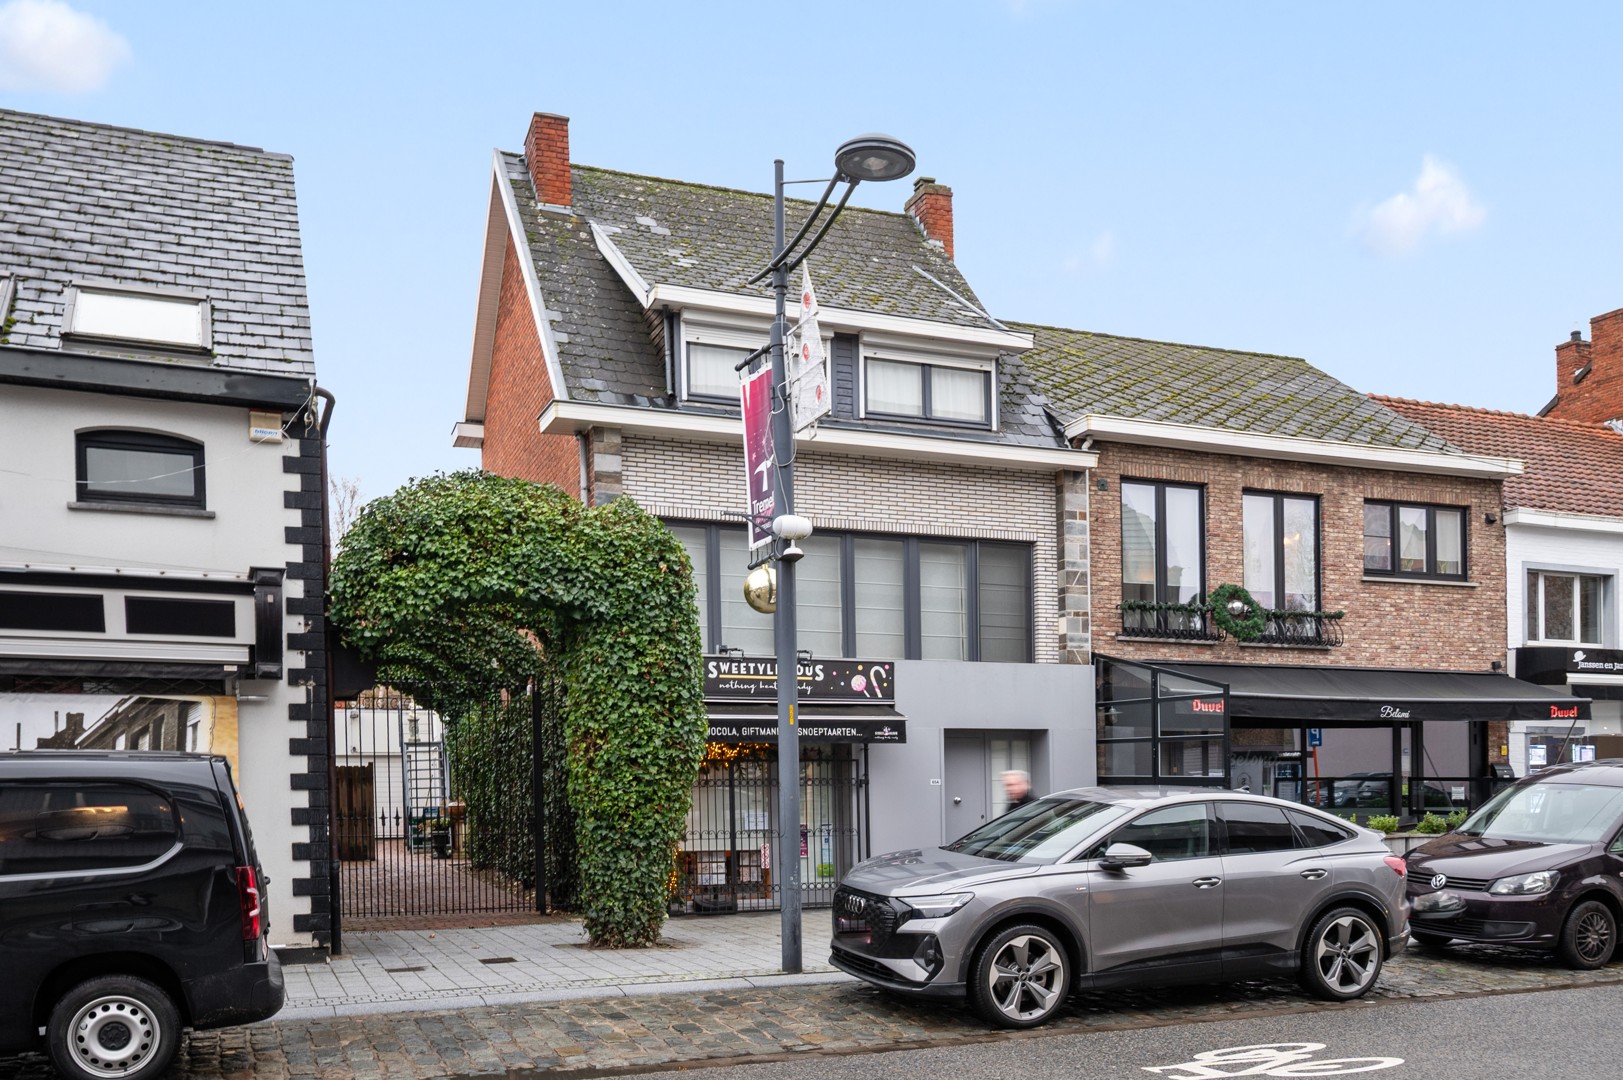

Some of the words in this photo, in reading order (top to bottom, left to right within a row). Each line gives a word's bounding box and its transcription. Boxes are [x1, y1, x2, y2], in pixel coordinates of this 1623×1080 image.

[752, 491, 775, 515] Tremel
[707, 661, 824, 682] SWEETYLIOUS
[719, 680, 757, 694] nothing
[759, 681, 778, 689] beat
[1192, 698, 1225, 713] Duvel
[1550, 705, 1578, 718] Duvel
[707, 726, 739, 737] OCOLA,
[741, 727, 779, 736] GIFTMAN
[797, 727, 863, 737] SNOEPTAARTEN...
